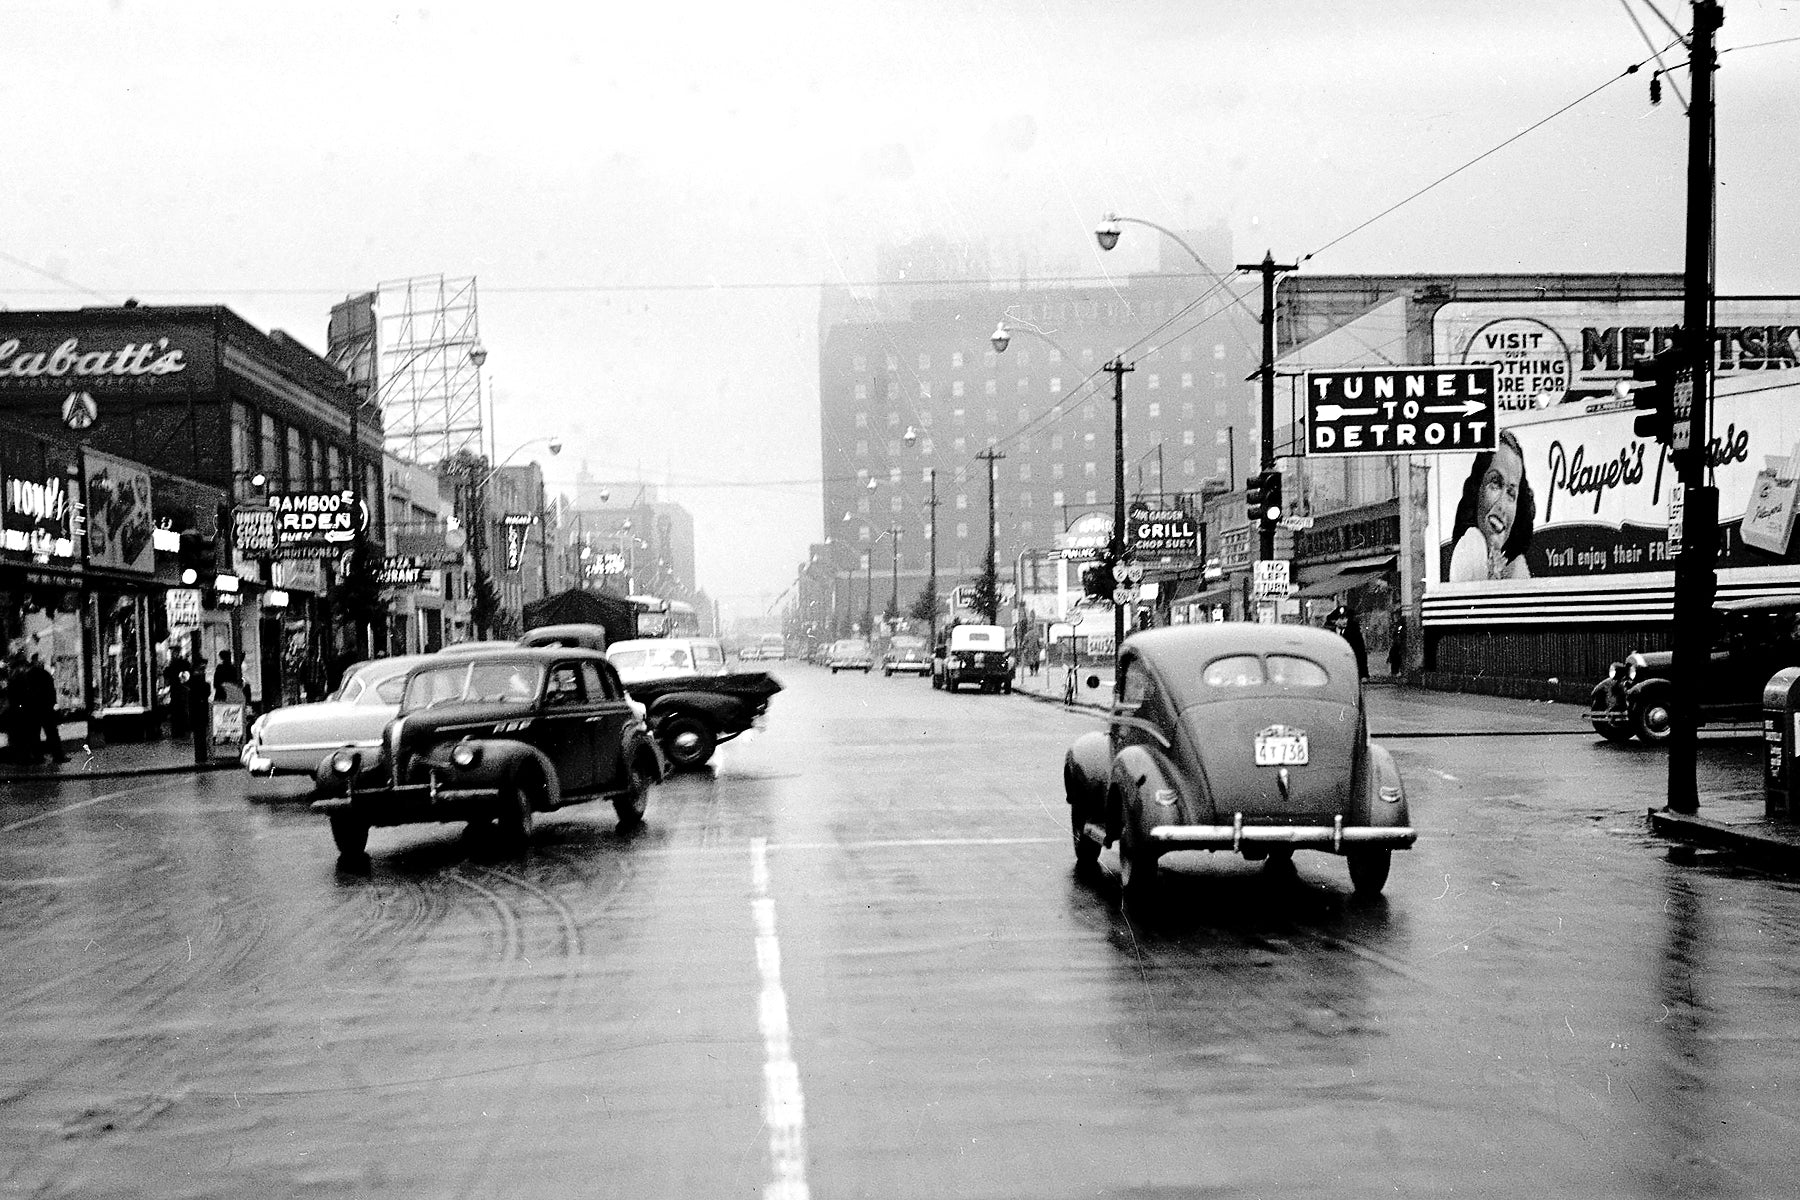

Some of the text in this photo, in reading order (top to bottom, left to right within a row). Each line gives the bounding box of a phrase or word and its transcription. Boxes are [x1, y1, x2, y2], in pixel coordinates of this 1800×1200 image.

[1485, 333, 1543, 349] VISIT
[1505, 351, 1527, 359] OUR
[1313, 373, 1487, 400] TUNNEL
[1532, 377, 1565, 392] FOR
[1382, 400, 1419, 420] TO
[1315, 422, 1488, 449] DETROIT
[1545, 440, 1646, 523] Player's
[269, 495, 340, 512] BAMBOO
[236, 512, 274, 525] UNITED
[236, 525, 274, 537] CIGAR
[1138, 522, 1194, 539] GRILL
[236, 537, 275, 550] STORE
[1135, 538, 1195, 549] CHOP SUEY
[1545, 547, 1574, 567] You'll
[1577, 546, 1607, 570] enjoy
[1613, 543, 1643, 564] their
[1267, 563, 1284, 571] NO
[1261, 583, 1288, 591] TURN
[174, 590, 192, 600] NO
[168, 602, 196, 610] LEFT
